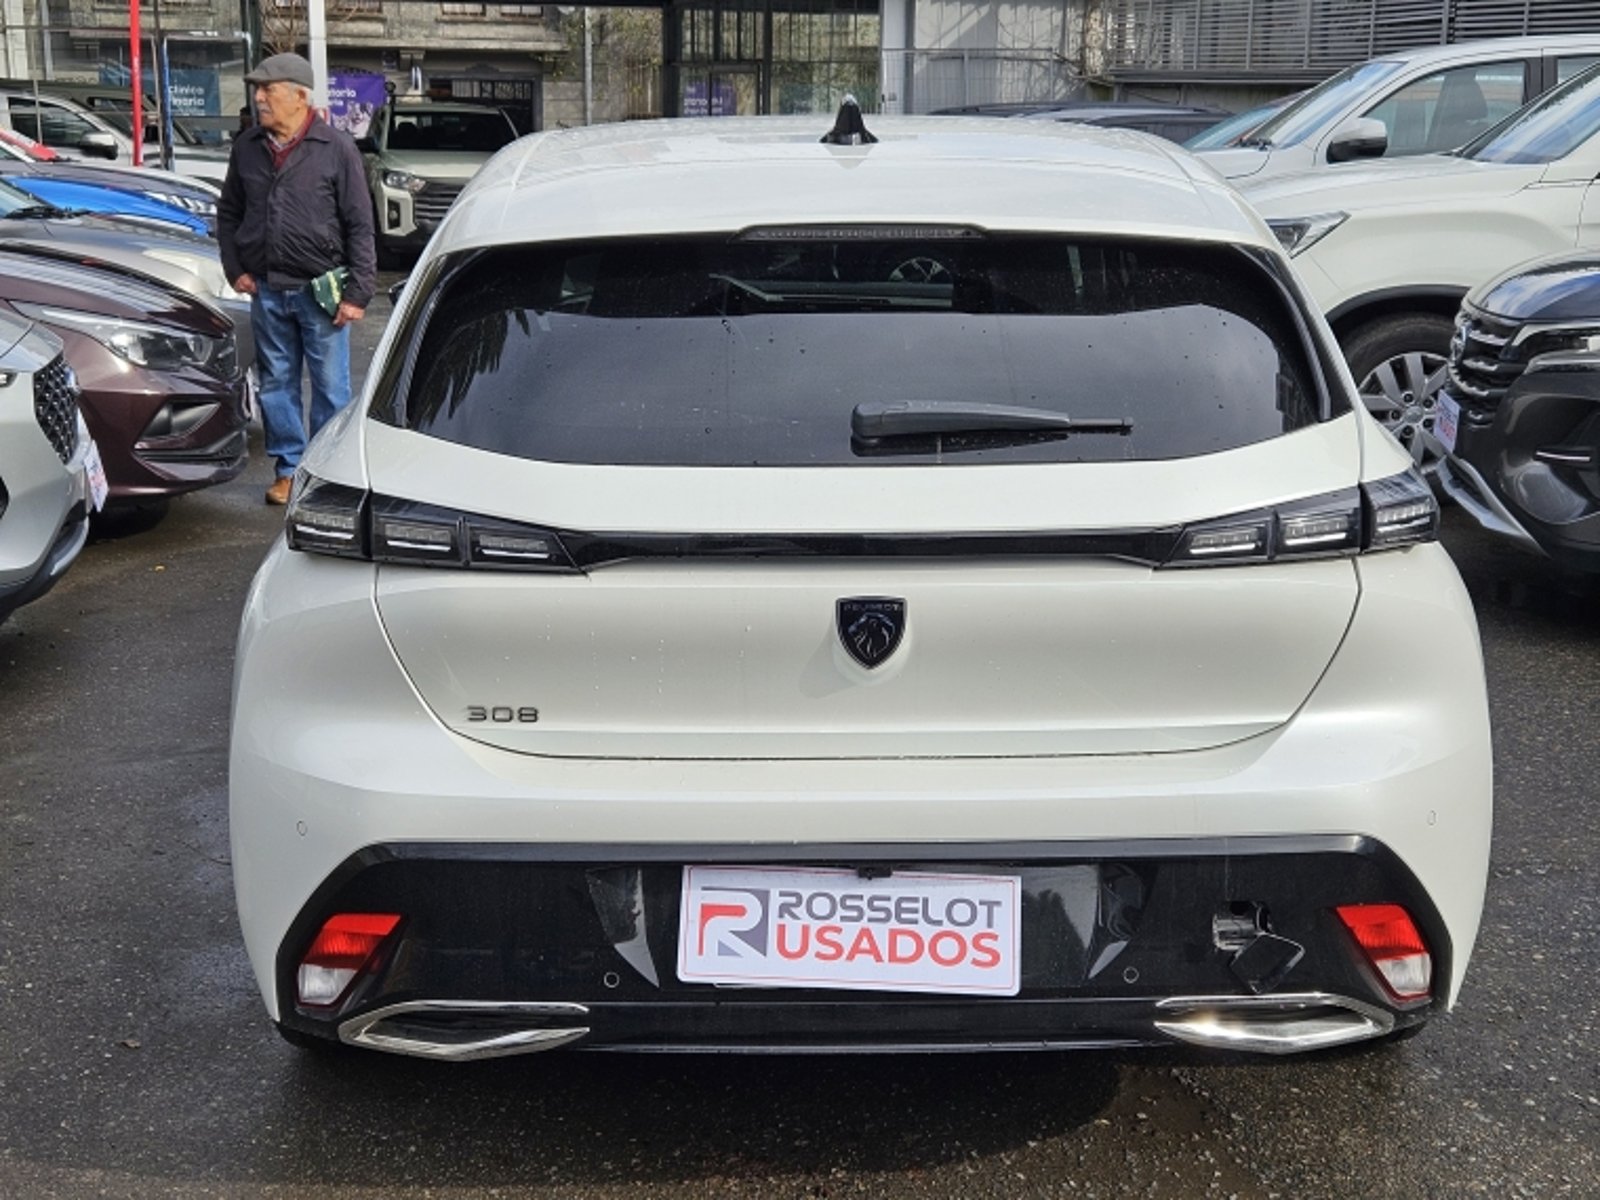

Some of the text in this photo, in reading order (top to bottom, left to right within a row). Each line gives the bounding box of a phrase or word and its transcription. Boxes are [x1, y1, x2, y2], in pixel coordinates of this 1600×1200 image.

[467, 706, 539, 723] 308
[778, 890, 1002, 929] ROSSELOT
[776, 923, 1001, 969] USADOS
